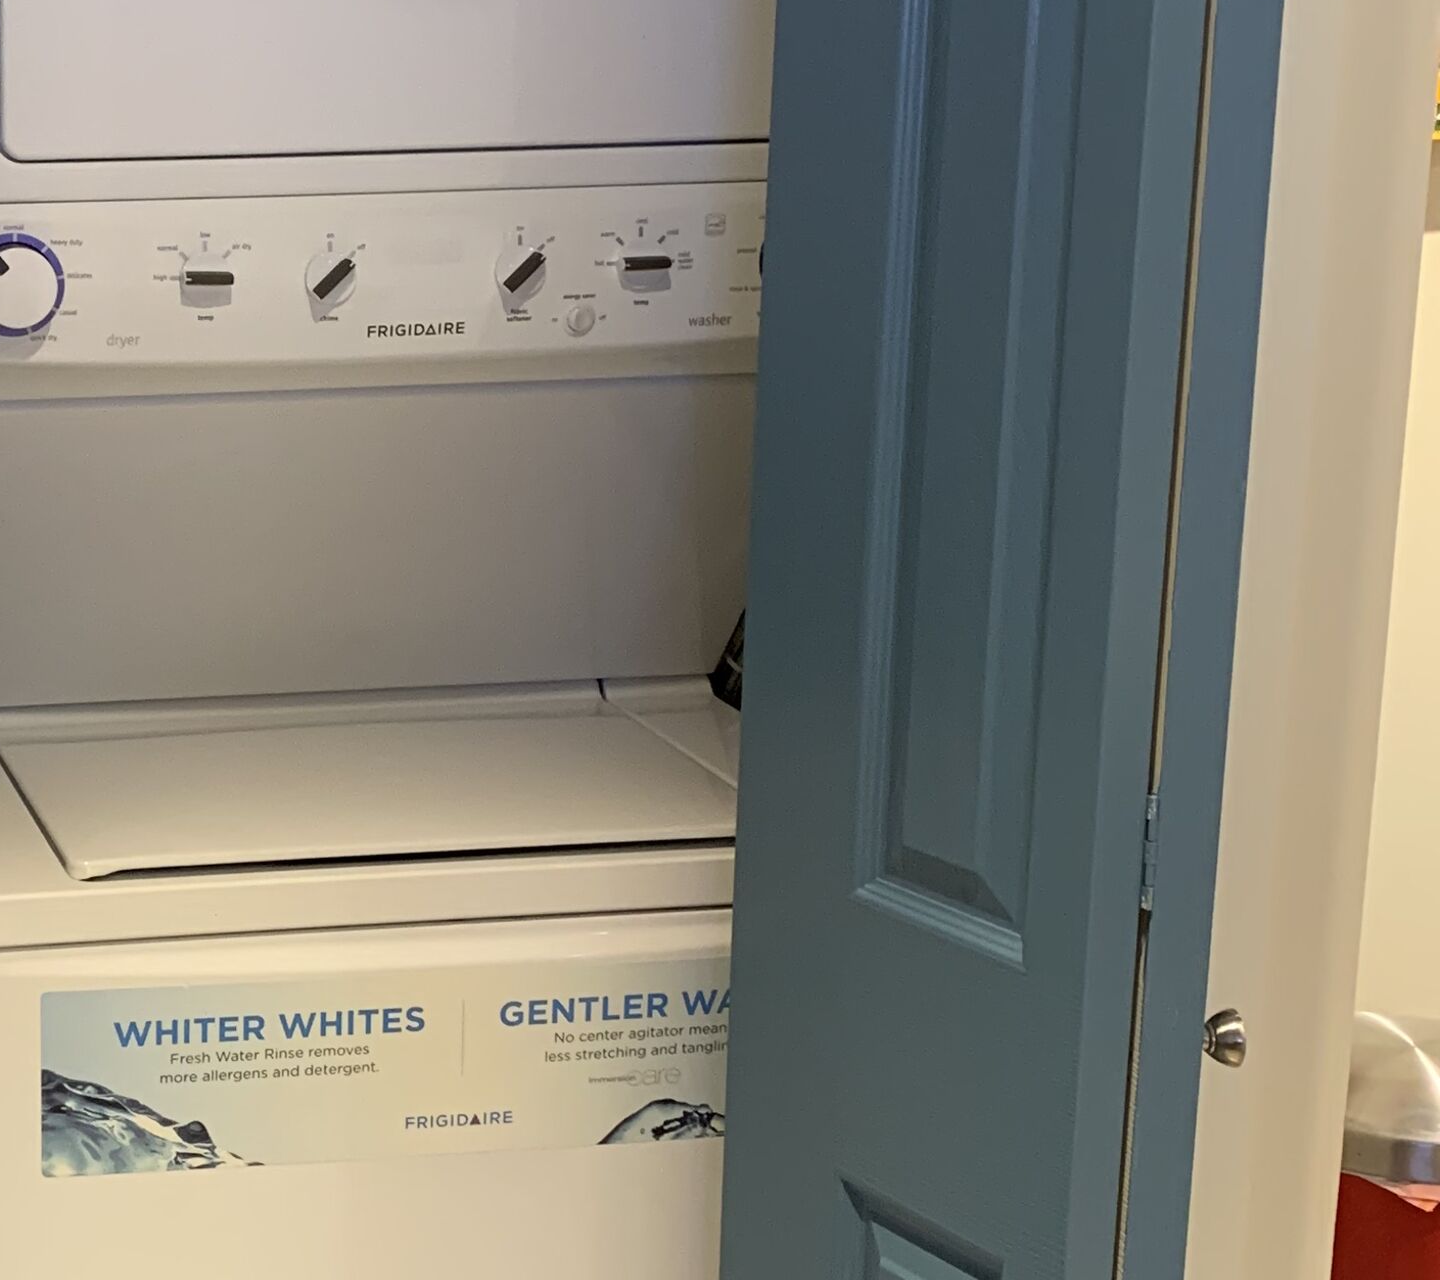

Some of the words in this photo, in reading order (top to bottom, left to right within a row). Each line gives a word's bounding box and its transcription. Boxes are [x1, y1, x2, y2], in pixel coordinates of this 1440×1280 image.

[367, 321, 465, 339] FRIGIDAIRE
[688, 313, 733, 327] washer
[106, 332, 140, 348] dryer
[499, 992, 669, 1027] GENTLER
[113, 1014, 266, 1048] WHITER
[279, 1006, 426, 1040] WHITES
[554, 1031, 575, 1044] No
[579, 1029, 624, 1043] center
[628, 1025, 684, 1041] agitator
[688, 1024, 728, 1036] mean
[170, 1051, 211, 1065] Fresh
[215, 1048, 260, 1063] Water
[264, 1046, 305, 1061] Rinse
[308, 1044, 370, 1058] removes
[544, 1050, 571, 1063] less
[575, 1045, 647, 1061] stretching
[650, 1042, 678, 1056] and
[160, 1072, 198, 1085] more
[202, 1066, 268, 1085] allergens
[272, 1064, 301, 1079] and
[304, 1061, 380, 1080] detergent.
[625, 1067, 681, 1087] care
[404, 1110, 514, 1129] FRIGIDAIRE
